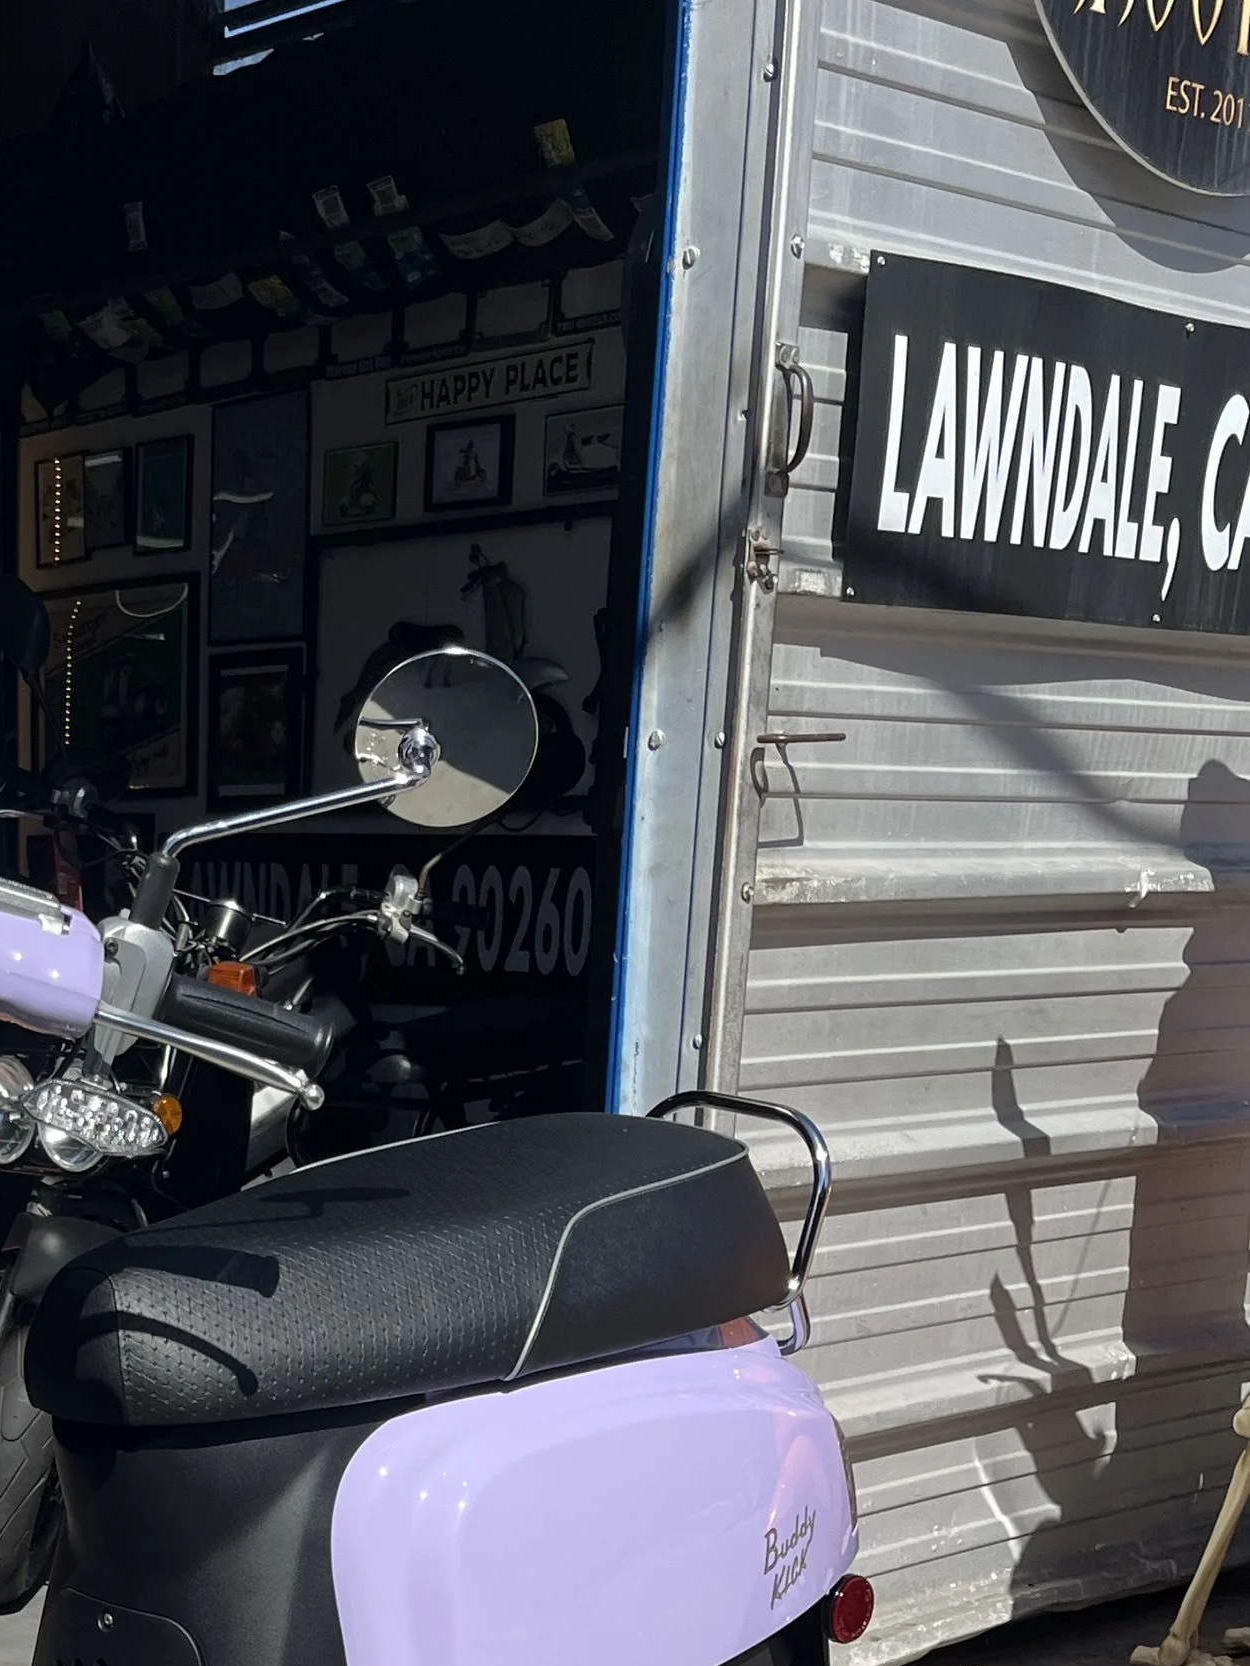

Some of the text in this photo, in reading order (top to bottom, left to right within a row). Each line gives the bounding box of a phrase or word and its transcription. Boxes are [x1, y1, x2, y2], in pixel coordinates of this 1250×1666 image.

[1165, 75, 1250, 132] EST. 201
[420, 368, 495, 411] HAPPY
[505, 352, 579, 395] PLACE
[877, 334, 1181, 602] LAWNDALE,
[451, 863, 593, 977] 90260
[763, 1505, 817, 1576] Buddy
